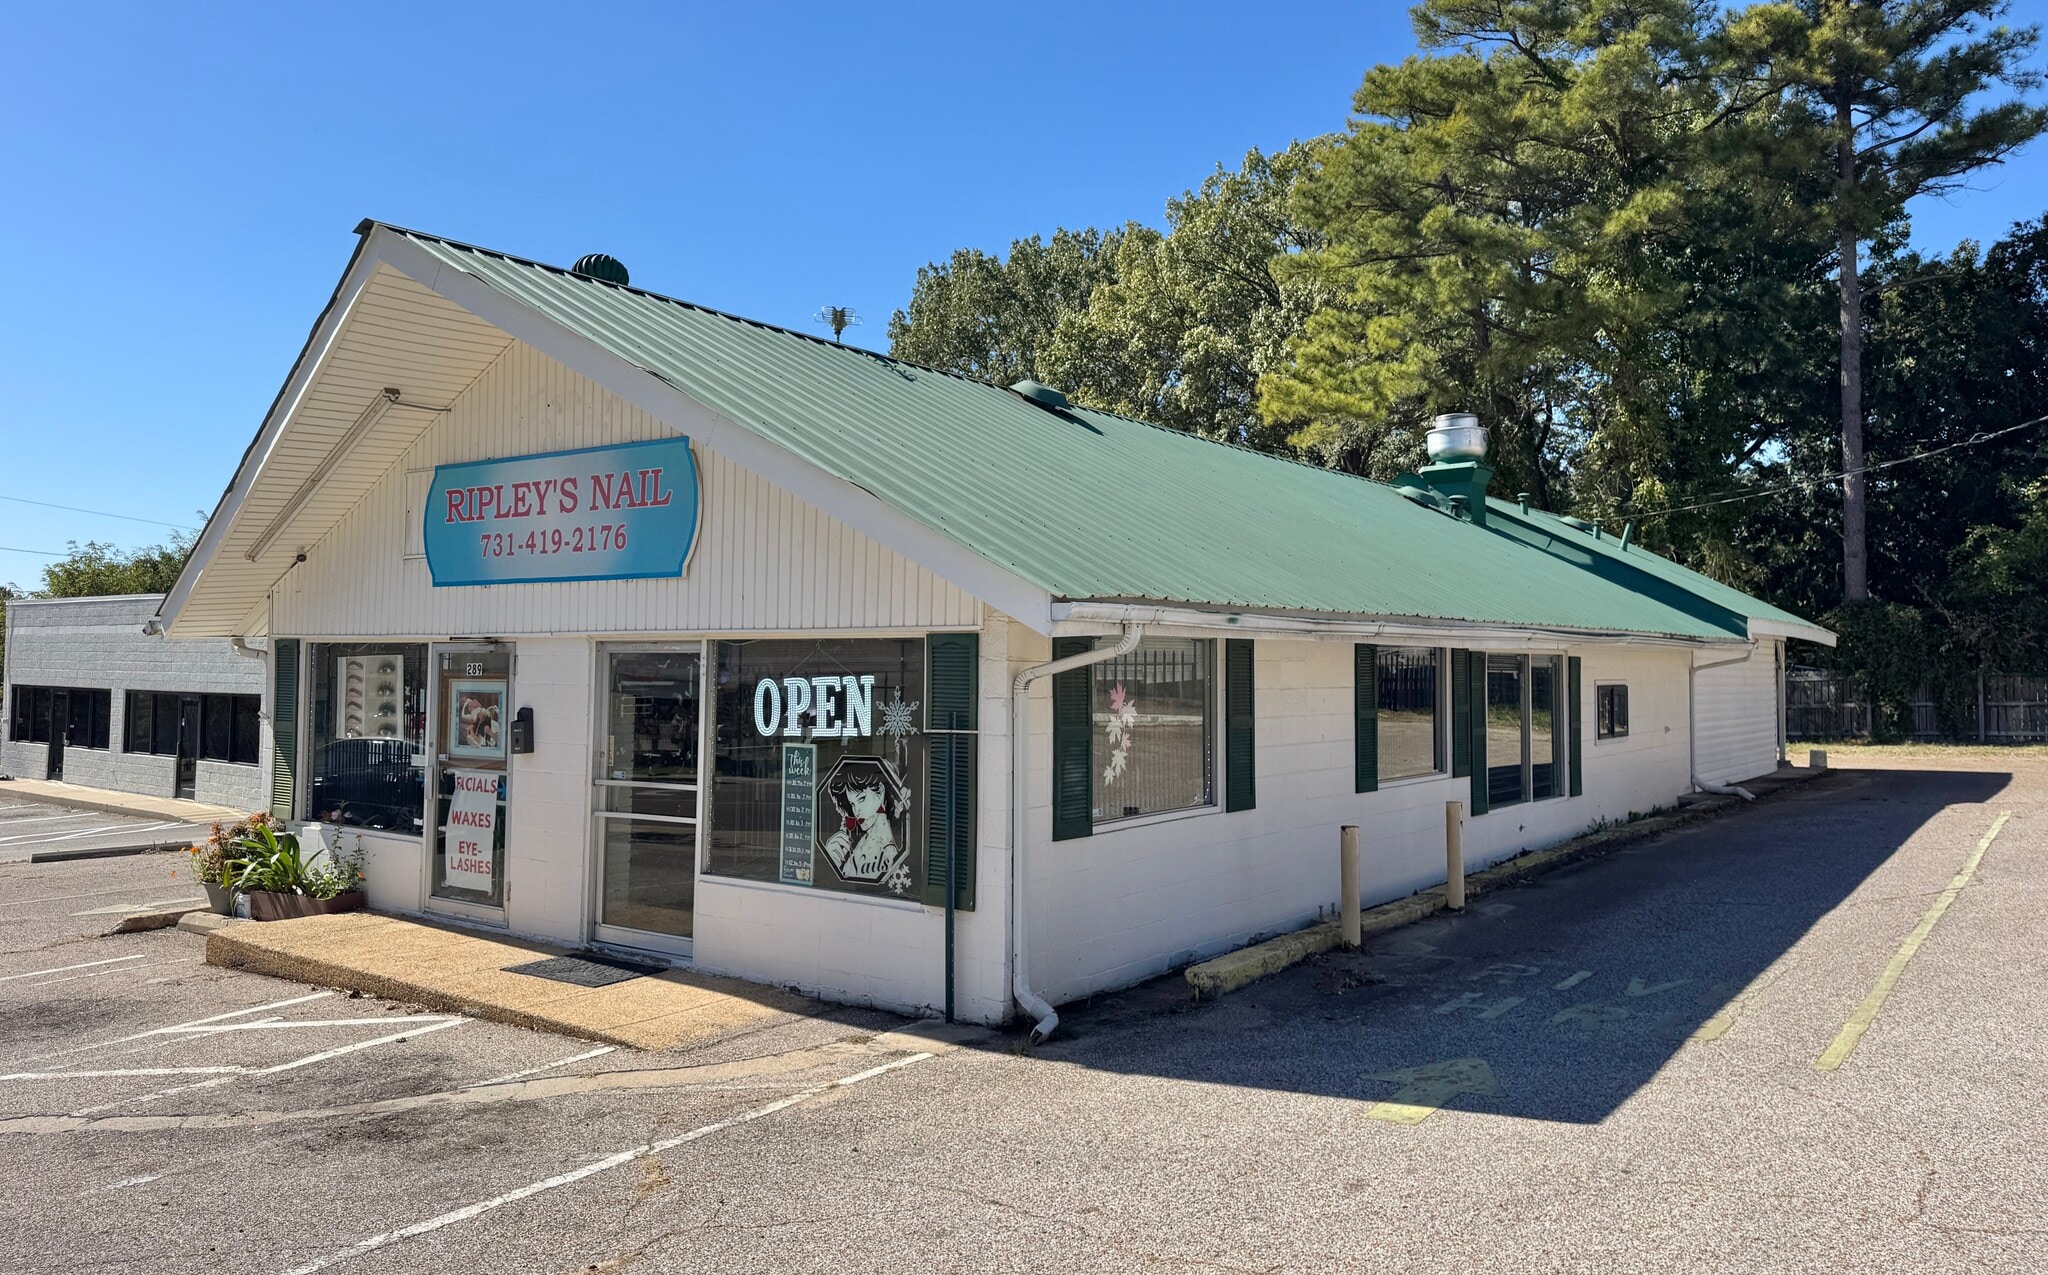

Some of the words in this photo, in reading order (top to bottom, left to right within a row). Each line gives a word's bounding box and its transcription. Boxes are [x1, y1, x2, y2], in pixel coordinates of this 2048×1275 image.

[445, 476, 579, 524] RIPLEY'S
[588, 467, 673, 512] NAIL
[480, 522, 628, 558] 731-419-2176
[467, 664, 482, 675] 289
[754, 675, 875, 737] OPEN
[788, 756, 811, 776] week
[455, 776, 498, 794] FACIALS
[452, 810, 492, 829] WAXES
[458, 841, 482, 856] EYE-
[450, 856, 492, 876] LASHES
[844, 851, 890, 875] Nails
